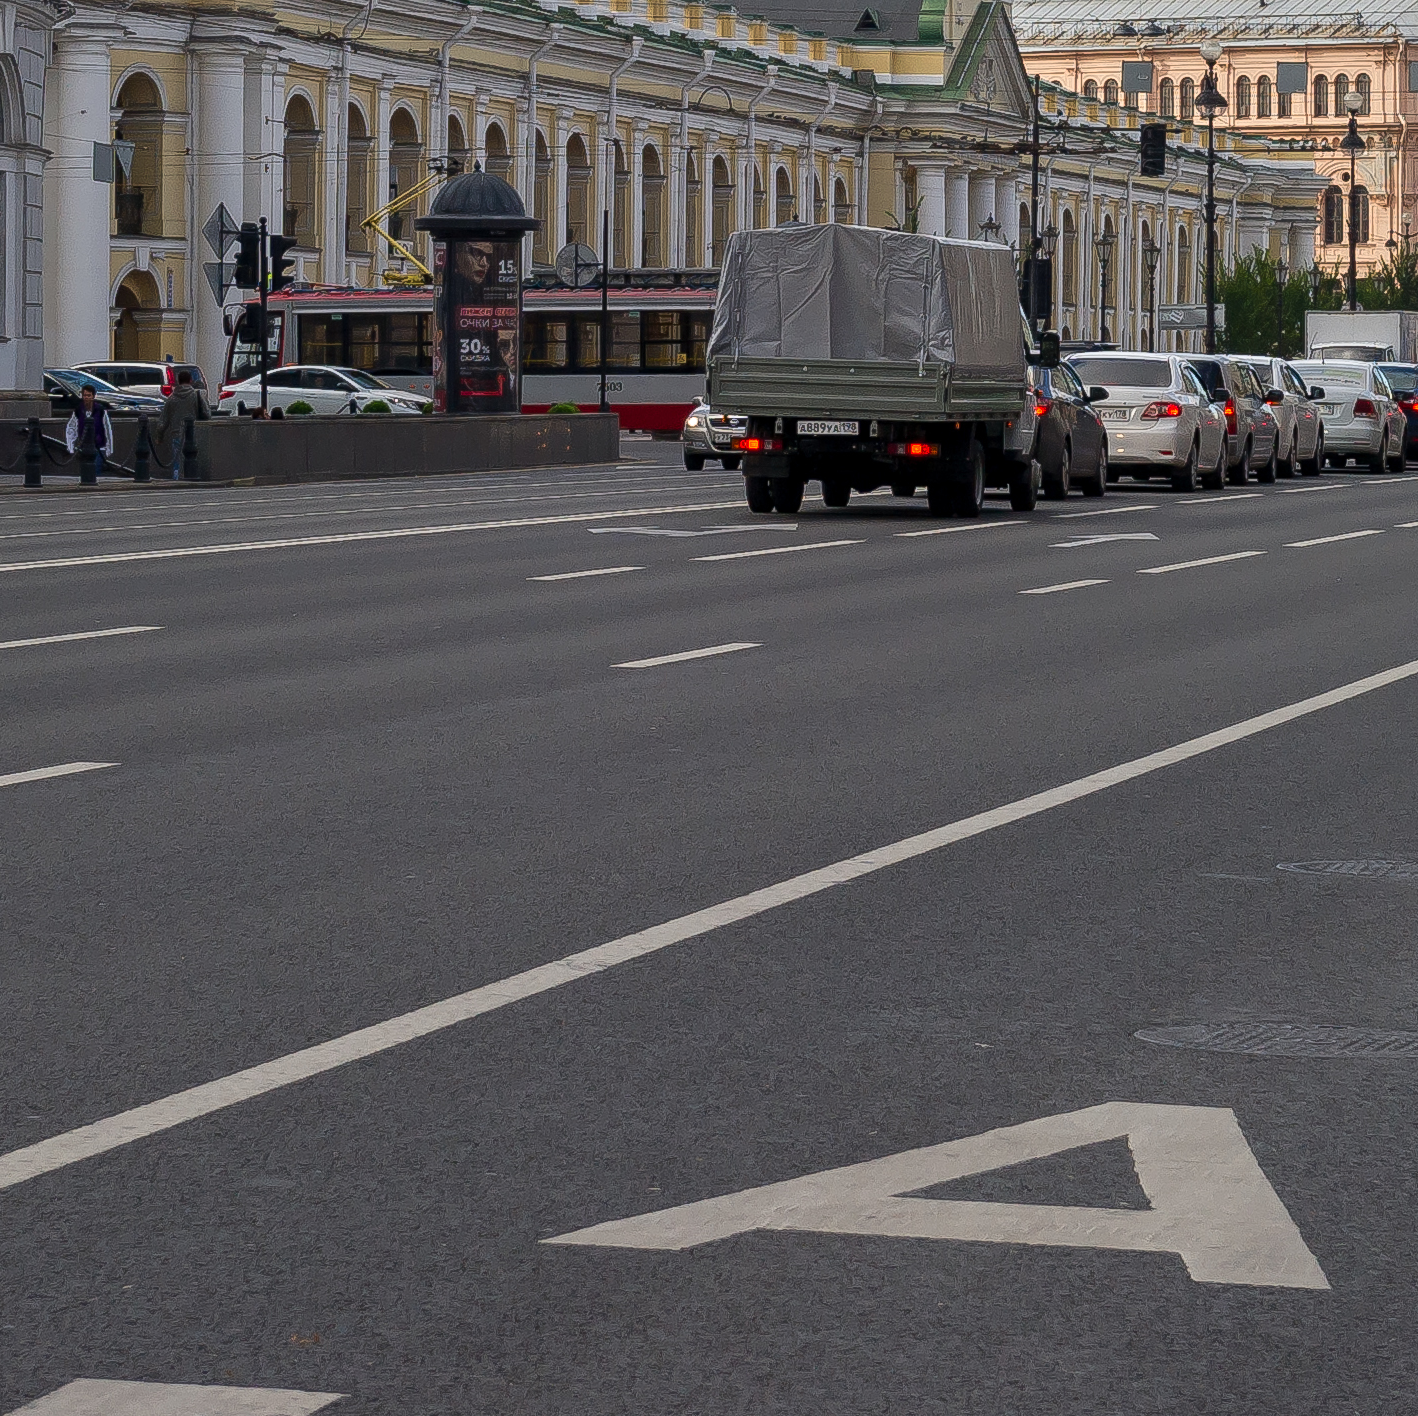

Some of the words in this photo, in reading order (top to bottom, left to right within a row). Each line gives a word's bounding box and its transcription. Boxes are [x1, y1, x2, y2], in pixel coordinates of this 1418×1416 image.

[460, 318, 490, 328] ОЧКИ
[460, 338, 491, 354] 30%
[539, 1100, 1332, 1290] А
